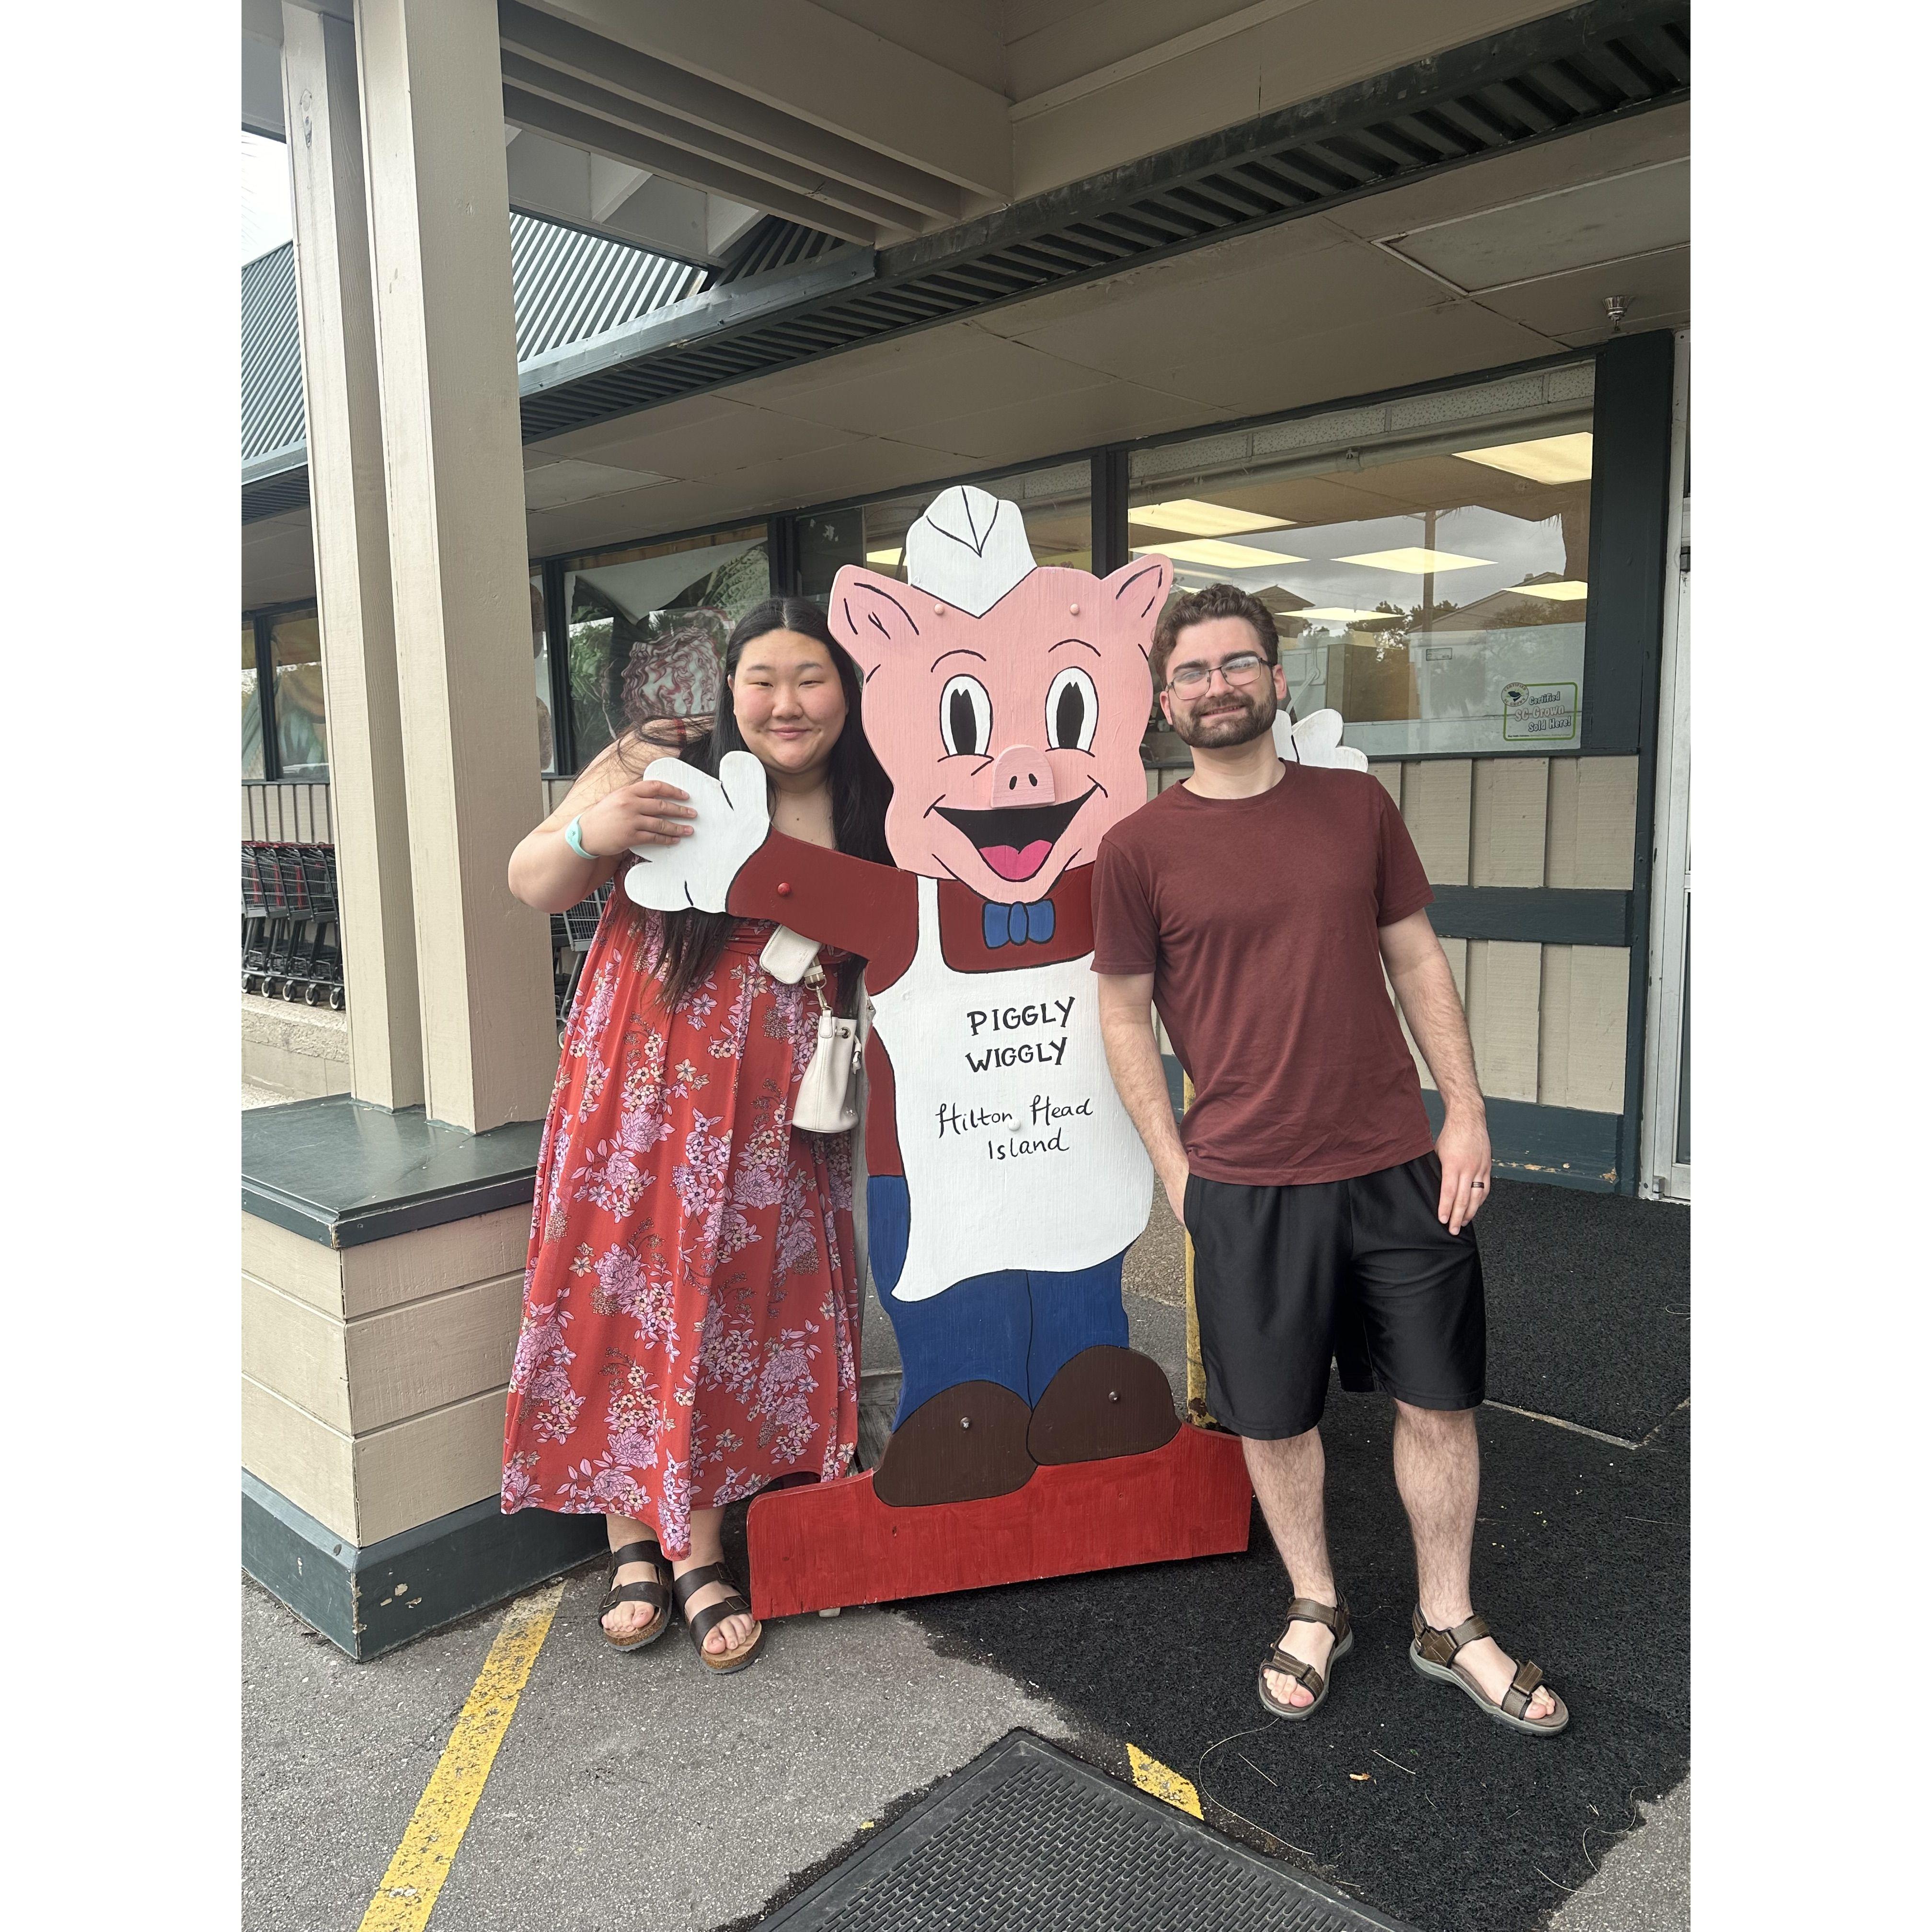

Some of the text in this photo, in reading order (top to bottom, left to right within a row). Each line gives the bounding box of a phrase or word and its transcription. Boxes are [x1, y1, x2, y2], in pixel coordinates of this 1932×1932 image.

[1515, 705, 1565, 722] SC Grown
[1529, 691, 1561, 705] Certified
[1528, 715, 1572, 732] Sold Here!
[966, 996, 1076, 1036] PIGGLY
[965, 1036, 1068, 1072] WIGGLY
[935, 1094, 1093, 1138] Hilton Head
[988, 1127, 1070, 1160] Island
